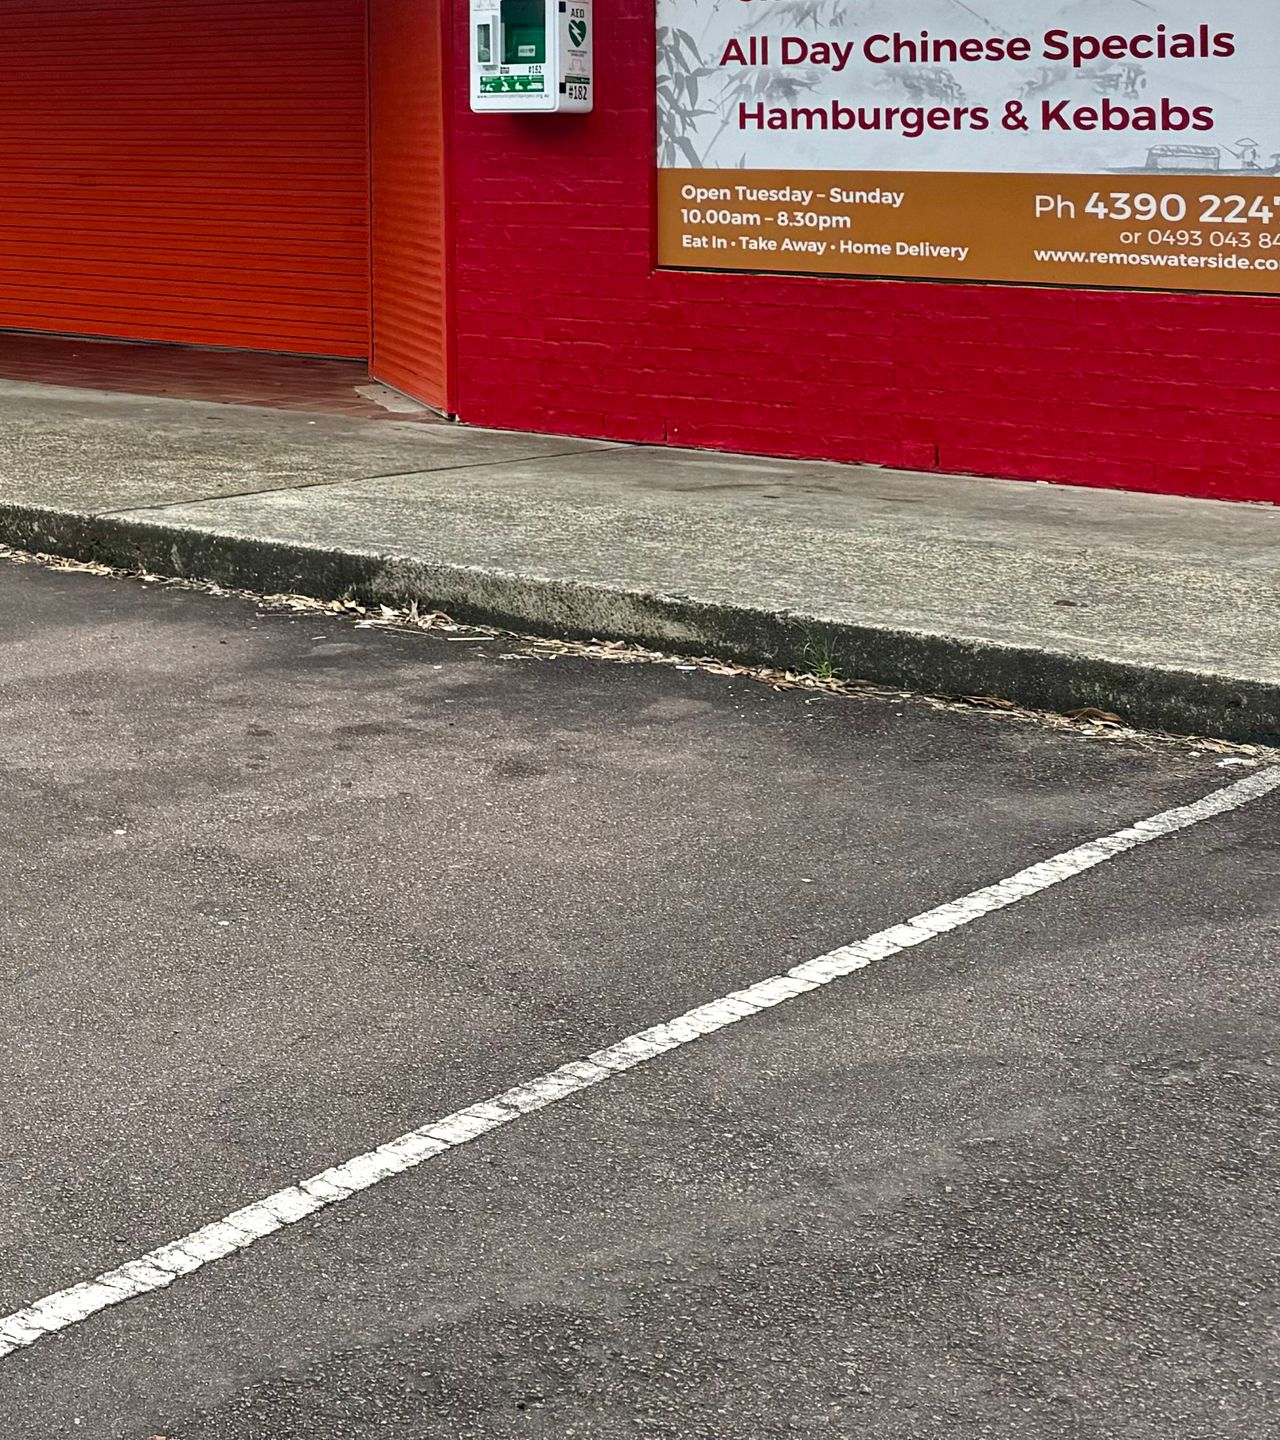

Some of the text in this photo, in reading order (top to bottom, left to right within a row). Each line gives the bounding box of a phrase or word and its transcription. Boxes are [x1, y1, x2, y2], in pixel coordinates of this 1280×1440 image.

[570, 8, 585, 19] AED
[720, 24, 1235, 73] All Day Chinese Specials
[568, 85, 588, 101] #182
[738, 97, 1214, 139] Hamburgers & Kebabs
[681, 185, 730, 203] Open
[735, 186, 813, 206] Tuesday
[829, 188, 904, 208] Sunday
[1035, 192, 1280, 224] Ph 4390 224
[681, 209, 761, 226] 10.00am
[777, 211, 851, 230] 8.30pm
[682, 235, 968, 260] Eat In Take Away Home Delivery
[1119, 231, 1142, 245] or
[1148, 229, 1203, 246] 0493
[1209, 231, 1251, 248] 043
[1034, 249, 1280, 271] www.remoswaterside.co
